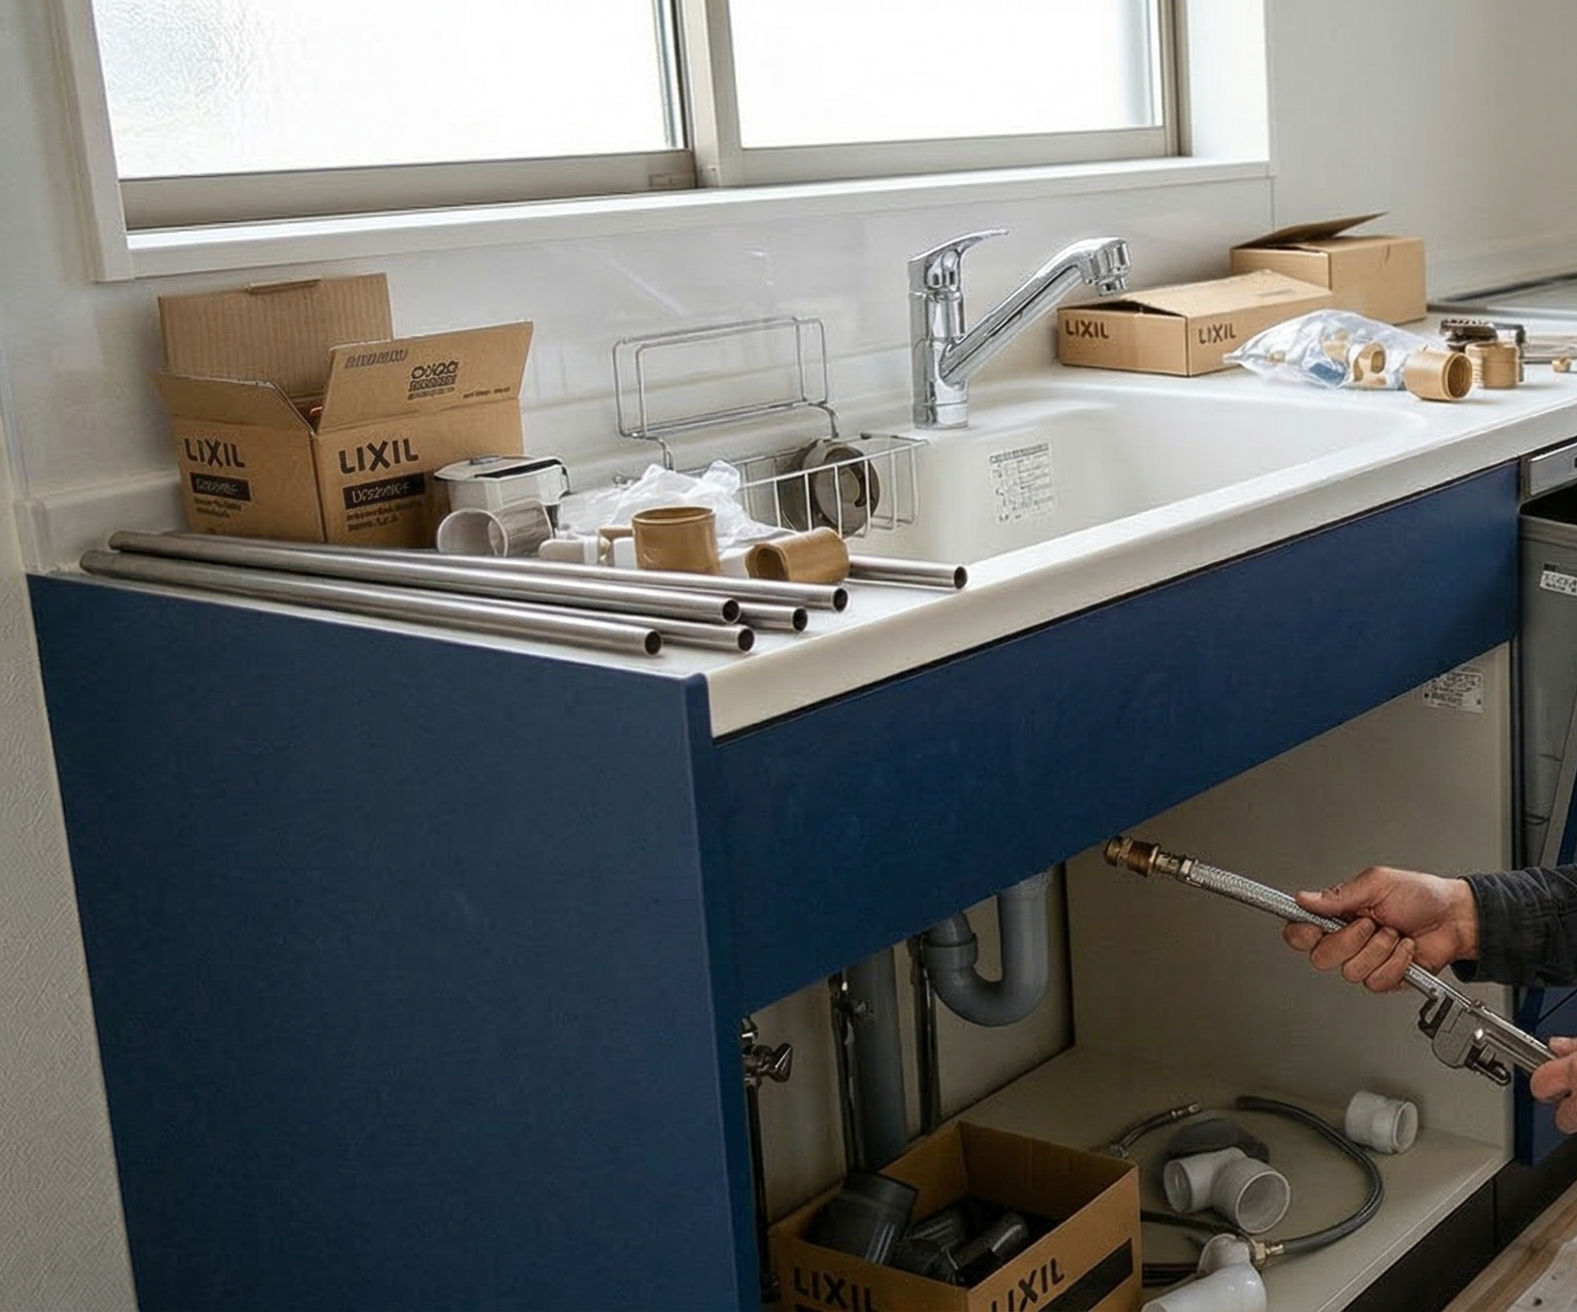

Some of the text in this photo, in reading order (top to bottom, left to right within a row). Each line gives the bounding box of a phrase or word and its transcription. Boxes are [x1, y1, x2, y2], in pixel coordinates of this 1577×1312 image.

[1064, 319, 1109, 339] LIXIL
[1198, 322, 1237, 344] LIXIL
[184, 438, 246, 468] LIXIL
[338, 437, 419, 474] LIXIL
